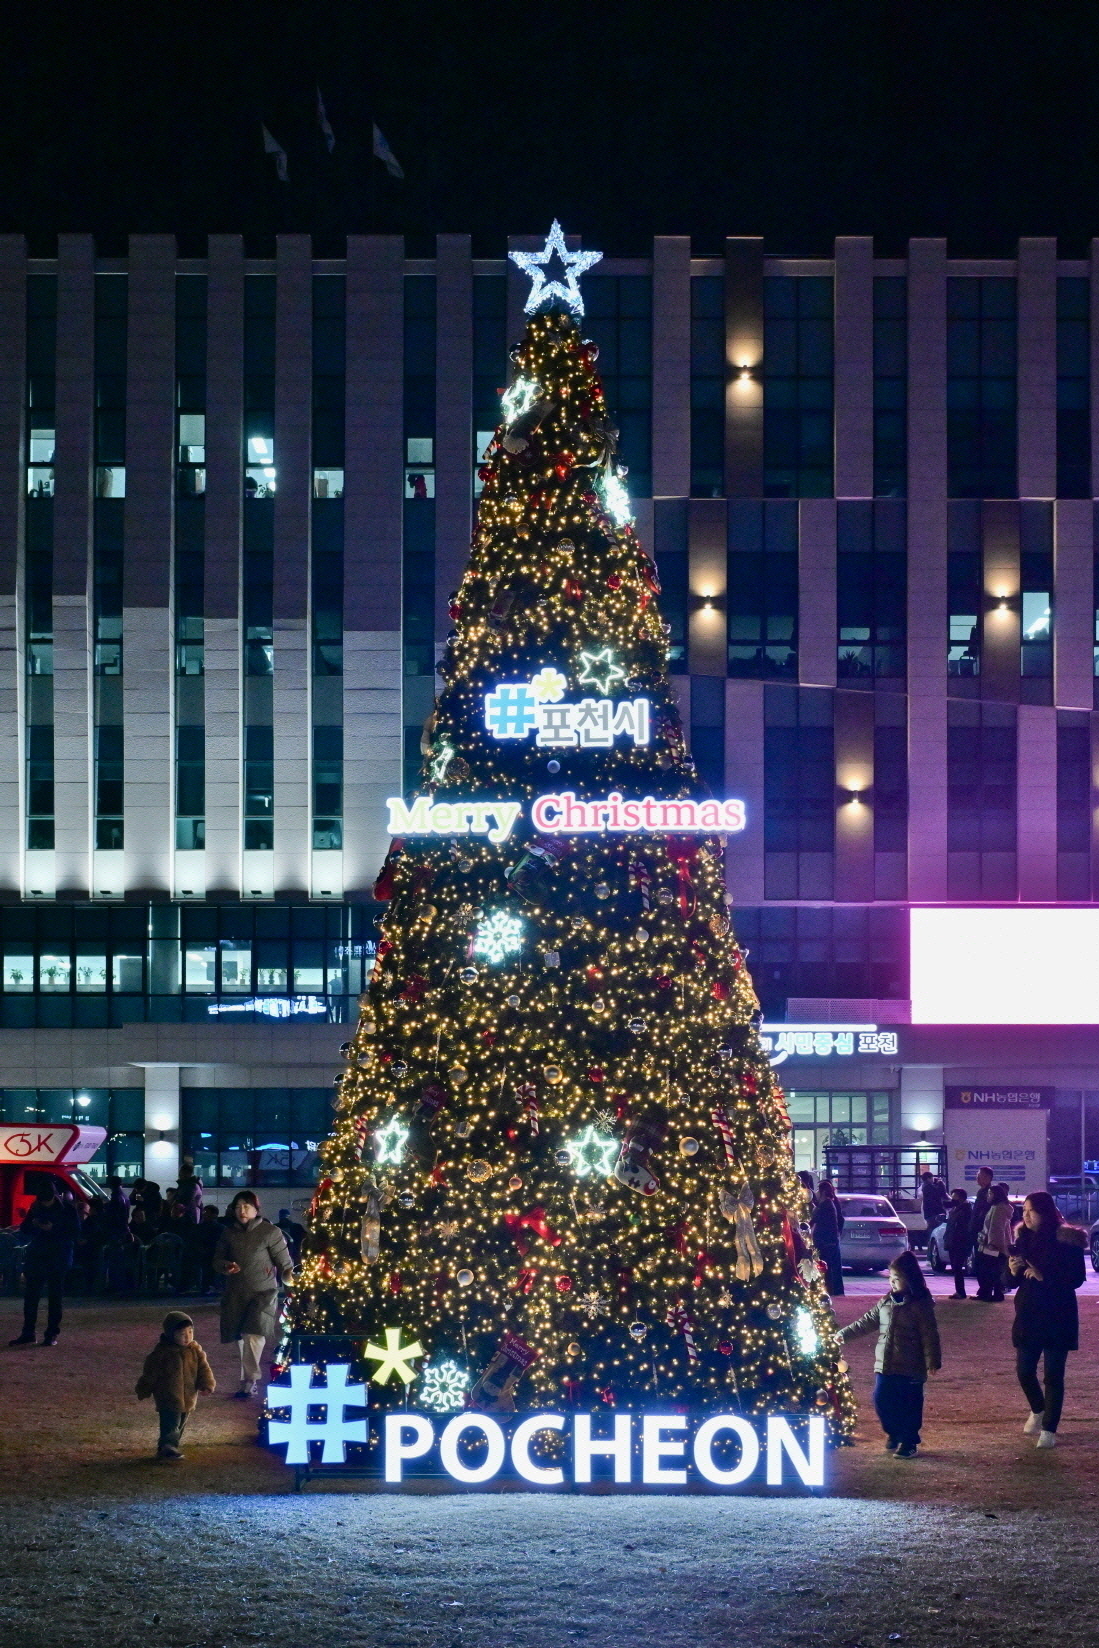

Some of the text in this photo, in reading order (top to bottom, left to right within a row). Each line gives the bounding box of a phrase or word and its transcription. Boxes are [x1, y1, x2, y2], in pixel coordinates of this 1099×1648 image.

[386, 791, 746, 844] Merry Christmas
[775, 1032, 853, 1055] 시민중심
[858, 1032, 898, 1054] 포천
[973, 1092, 1041, 1104] NH농협은행
[968, 1150, 1036, 1161] NH농협은행
